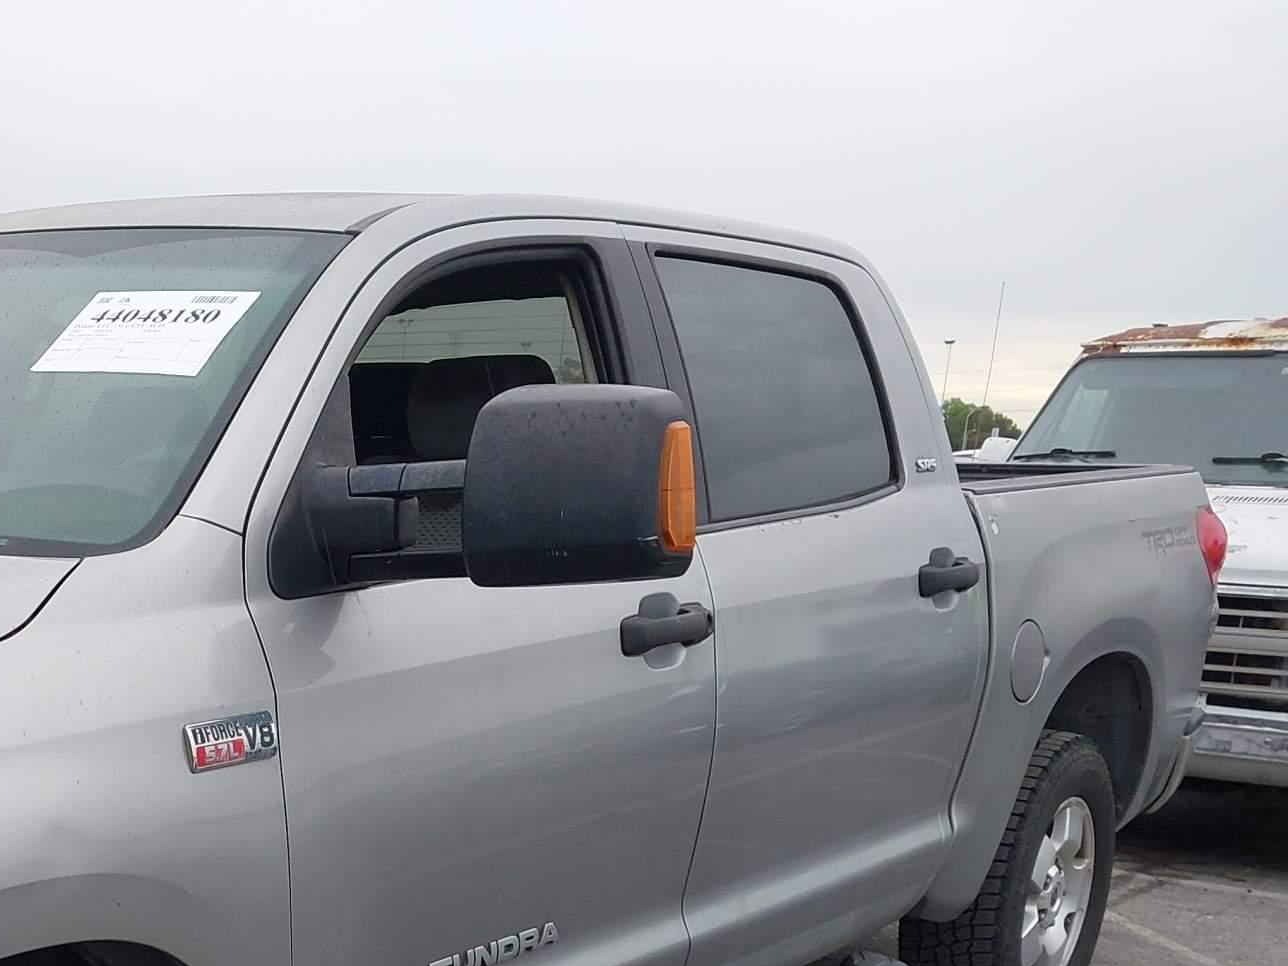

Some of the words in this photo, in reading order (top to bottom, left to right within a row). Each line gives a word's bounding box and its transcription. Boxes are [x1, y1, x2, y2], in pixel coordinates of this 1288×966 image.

[91, 308, 221, 324] 44048180
[1142, 528, 1174, 554] TRD
[242, 720, 275, 751] V8
